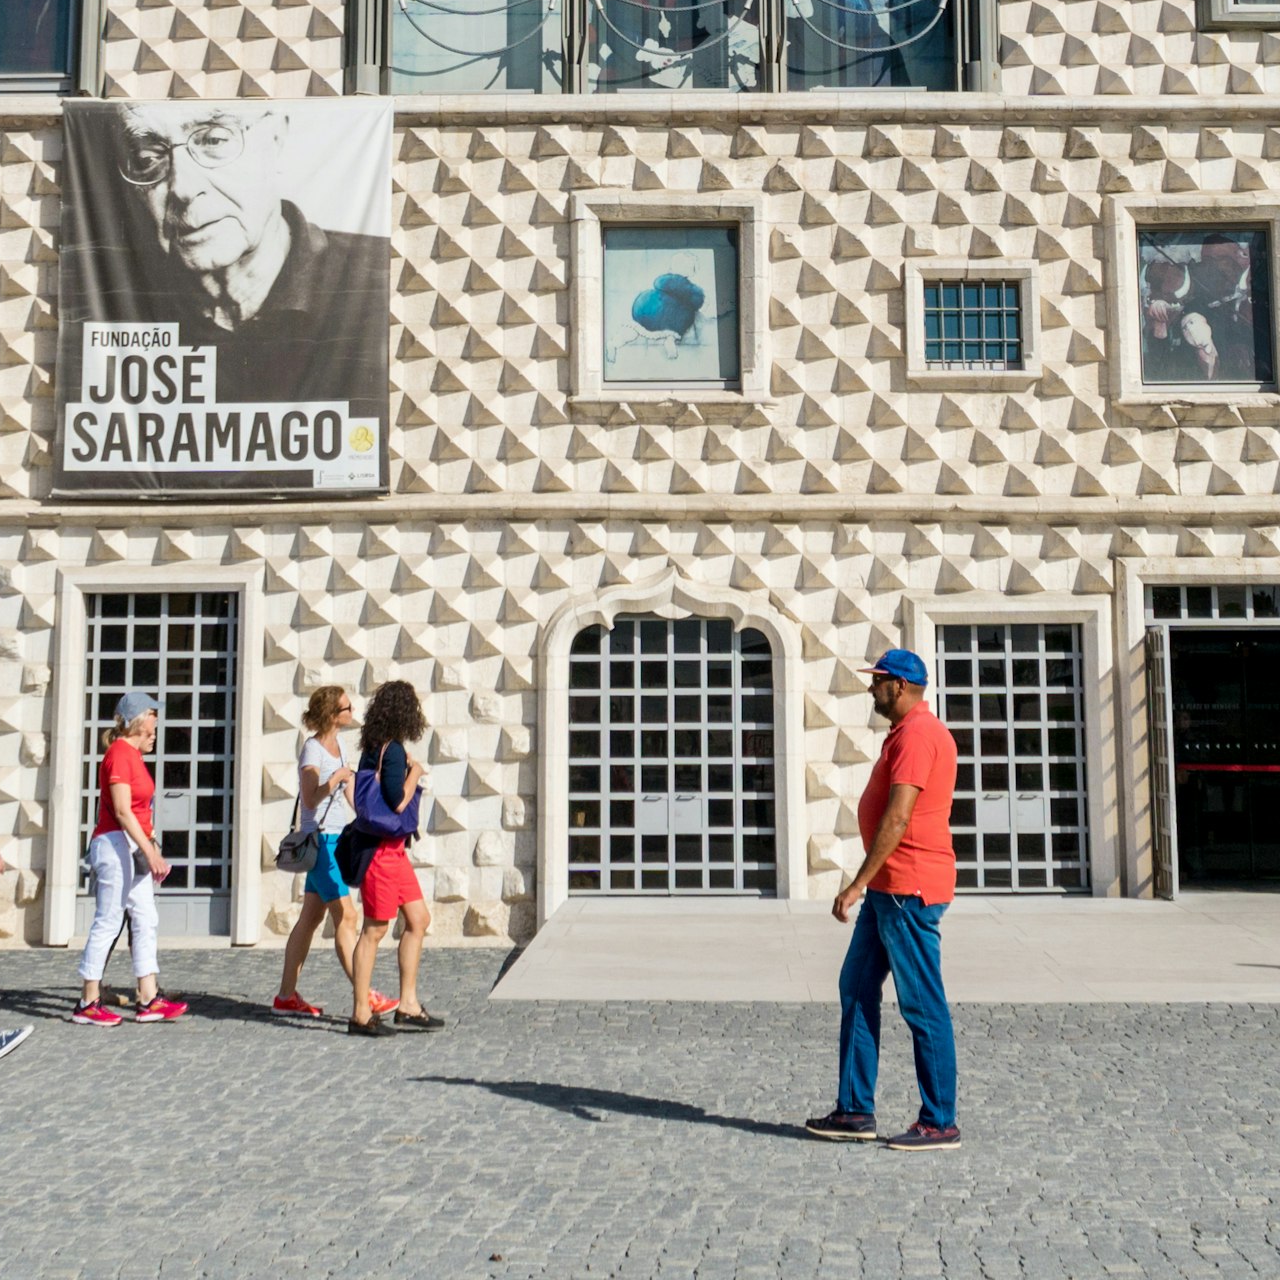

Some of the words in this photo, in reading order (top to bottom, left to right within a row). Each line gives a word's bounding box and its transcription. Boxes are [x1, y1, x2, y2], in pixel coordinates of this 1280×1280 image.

[91, 328, 171, 351] FUNDAÇÃO
[89, 346, 206, 405] JOSÉ
[71, 410, 342, 462] SARAMAGO
